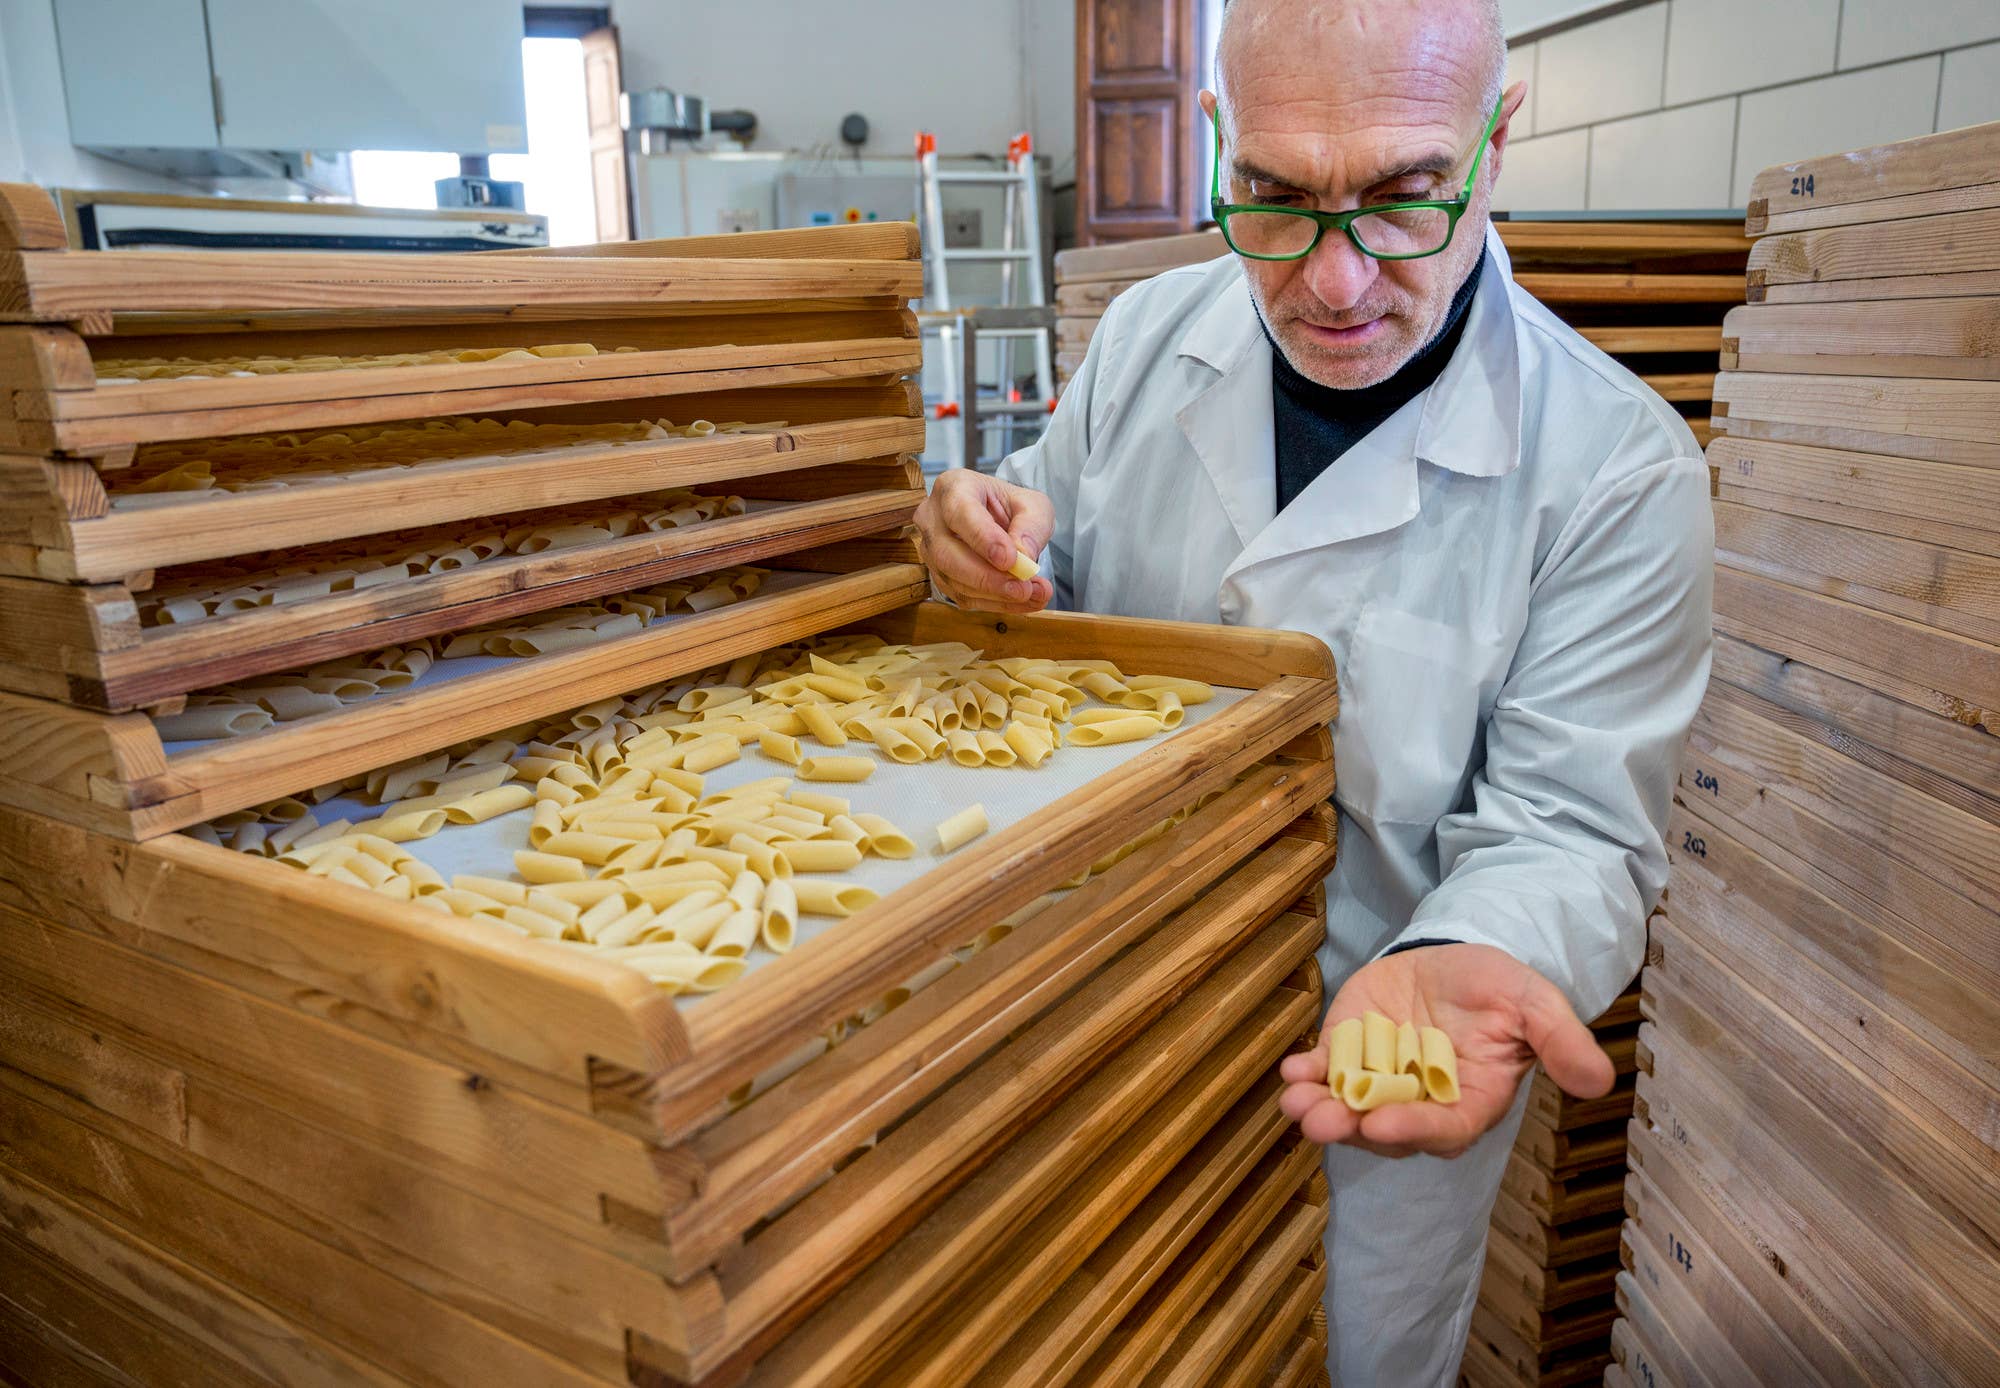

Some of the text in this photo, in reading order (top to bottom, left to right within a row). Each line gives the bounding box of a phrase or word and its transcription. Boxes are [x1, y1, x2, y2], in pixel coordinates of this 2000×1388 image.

[1791, 174, 1814, 198] 214
[1682, 831, 1707, 859] 207
[1669, 1231, 1693, 1274] 187
